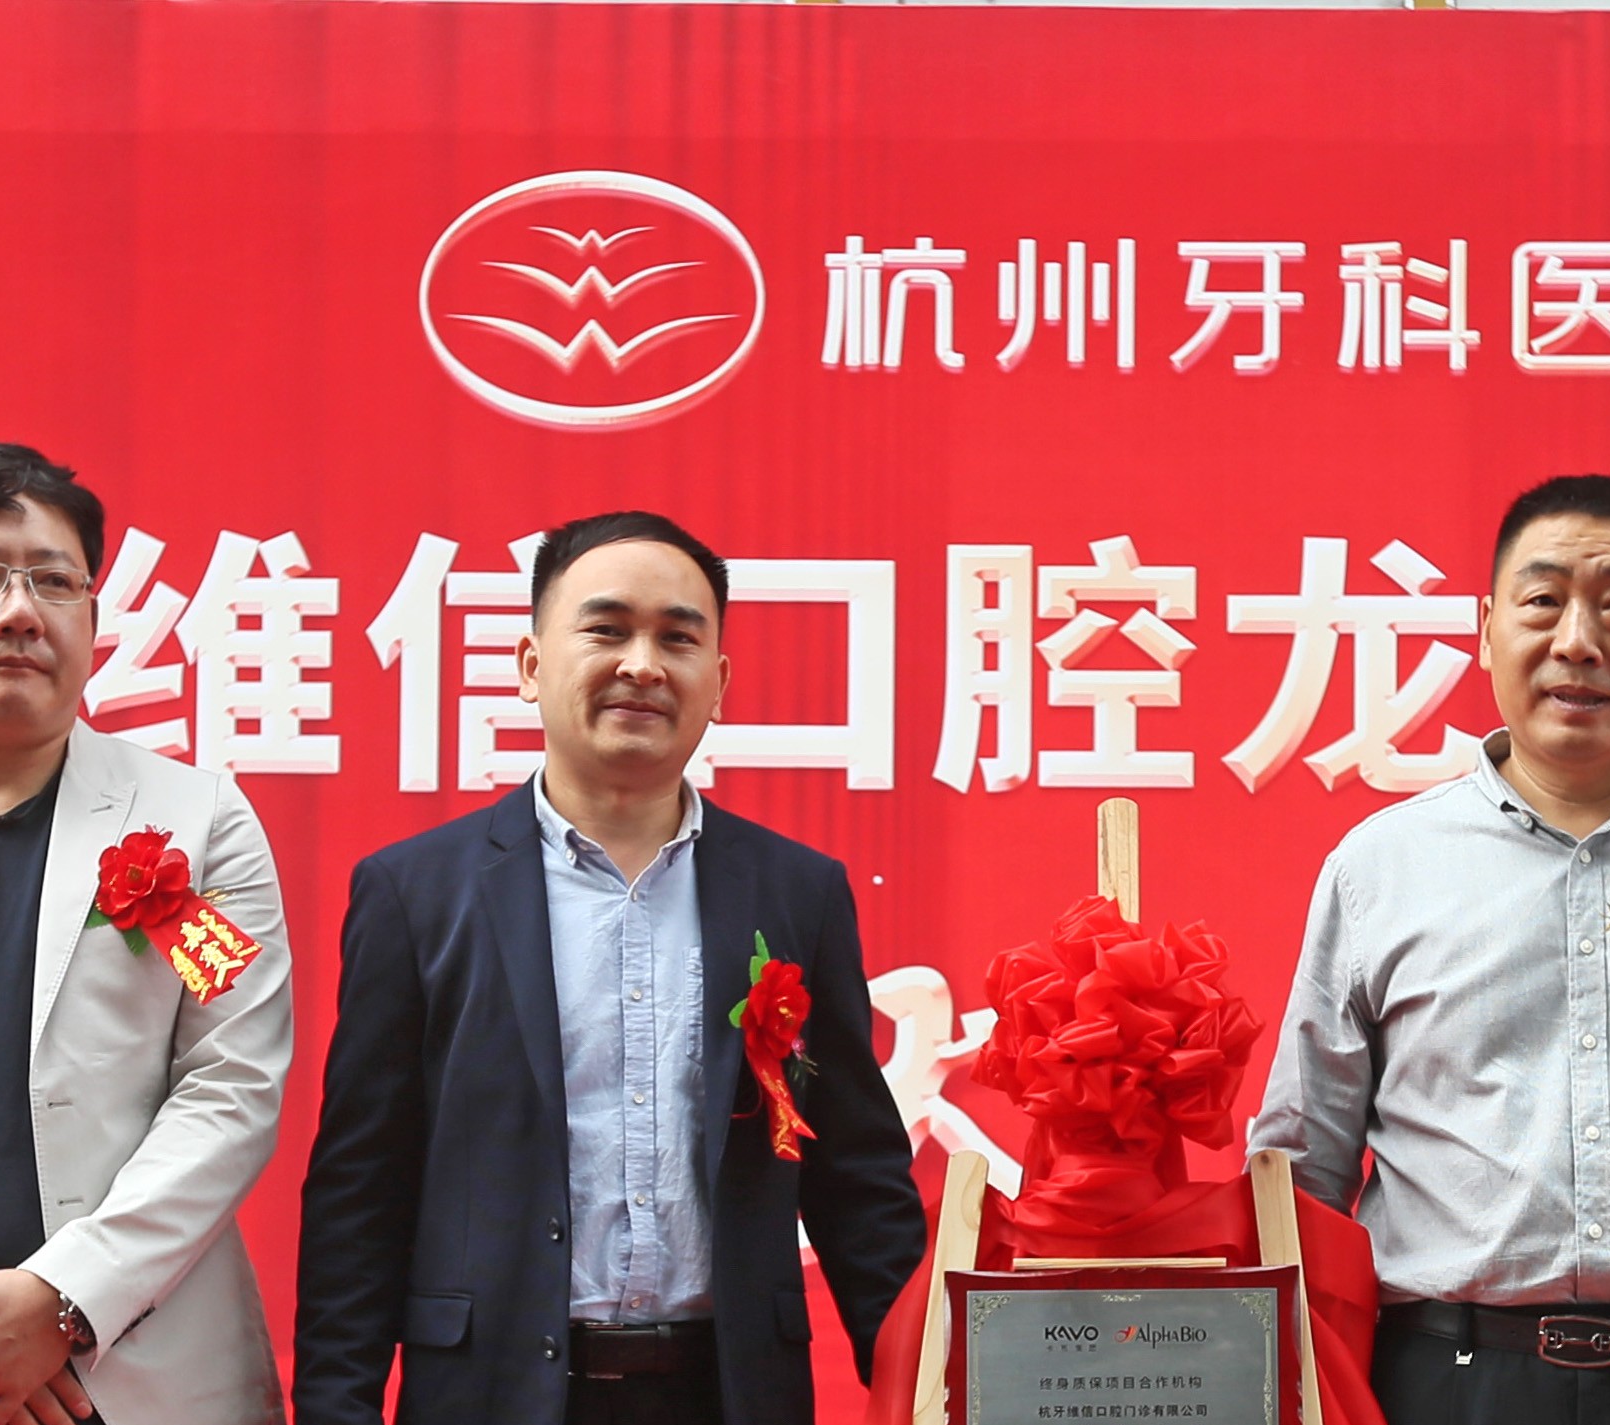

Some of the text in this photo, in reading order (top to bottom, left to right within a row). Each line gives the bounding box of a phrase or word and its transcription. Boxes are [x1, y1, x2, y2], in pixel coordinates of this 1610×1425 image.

[1040, 1376, 1203, 1390] 终身质保项目合作机构
[1038, 1404, 1208, 1418] 杭牙维信口腔门诊有限公司
